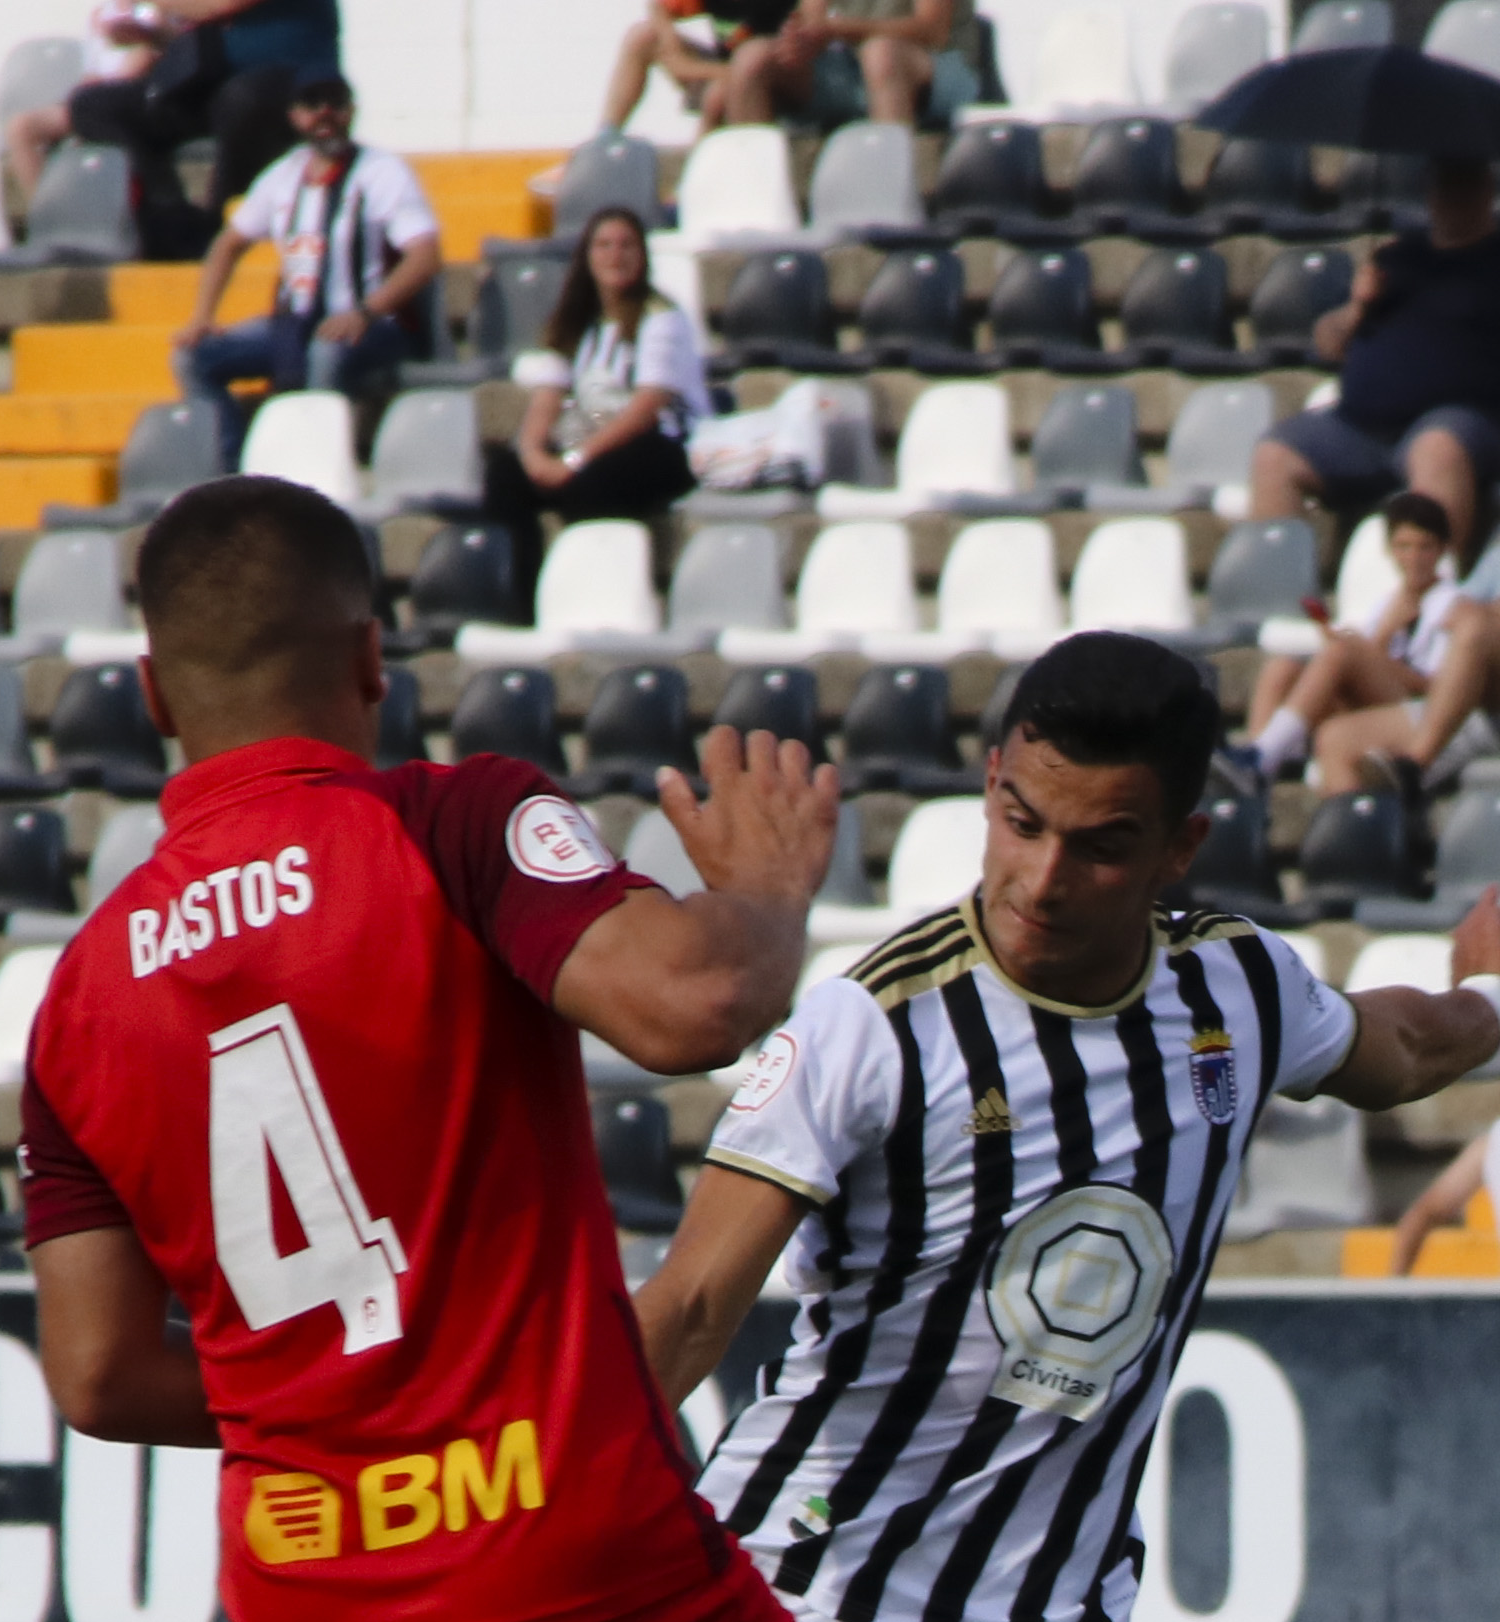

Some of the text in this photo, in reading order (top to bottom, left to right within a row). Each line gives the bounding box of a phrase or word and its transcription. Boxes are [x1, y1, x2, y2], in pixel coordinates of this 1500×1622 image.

[129, 846, 313, 978] BASTOS
[207, 1002, 408, 1355] 4
[1010, 1359, 1097, 1399] Civitas
[357, 1419, 546, 1551] BM
